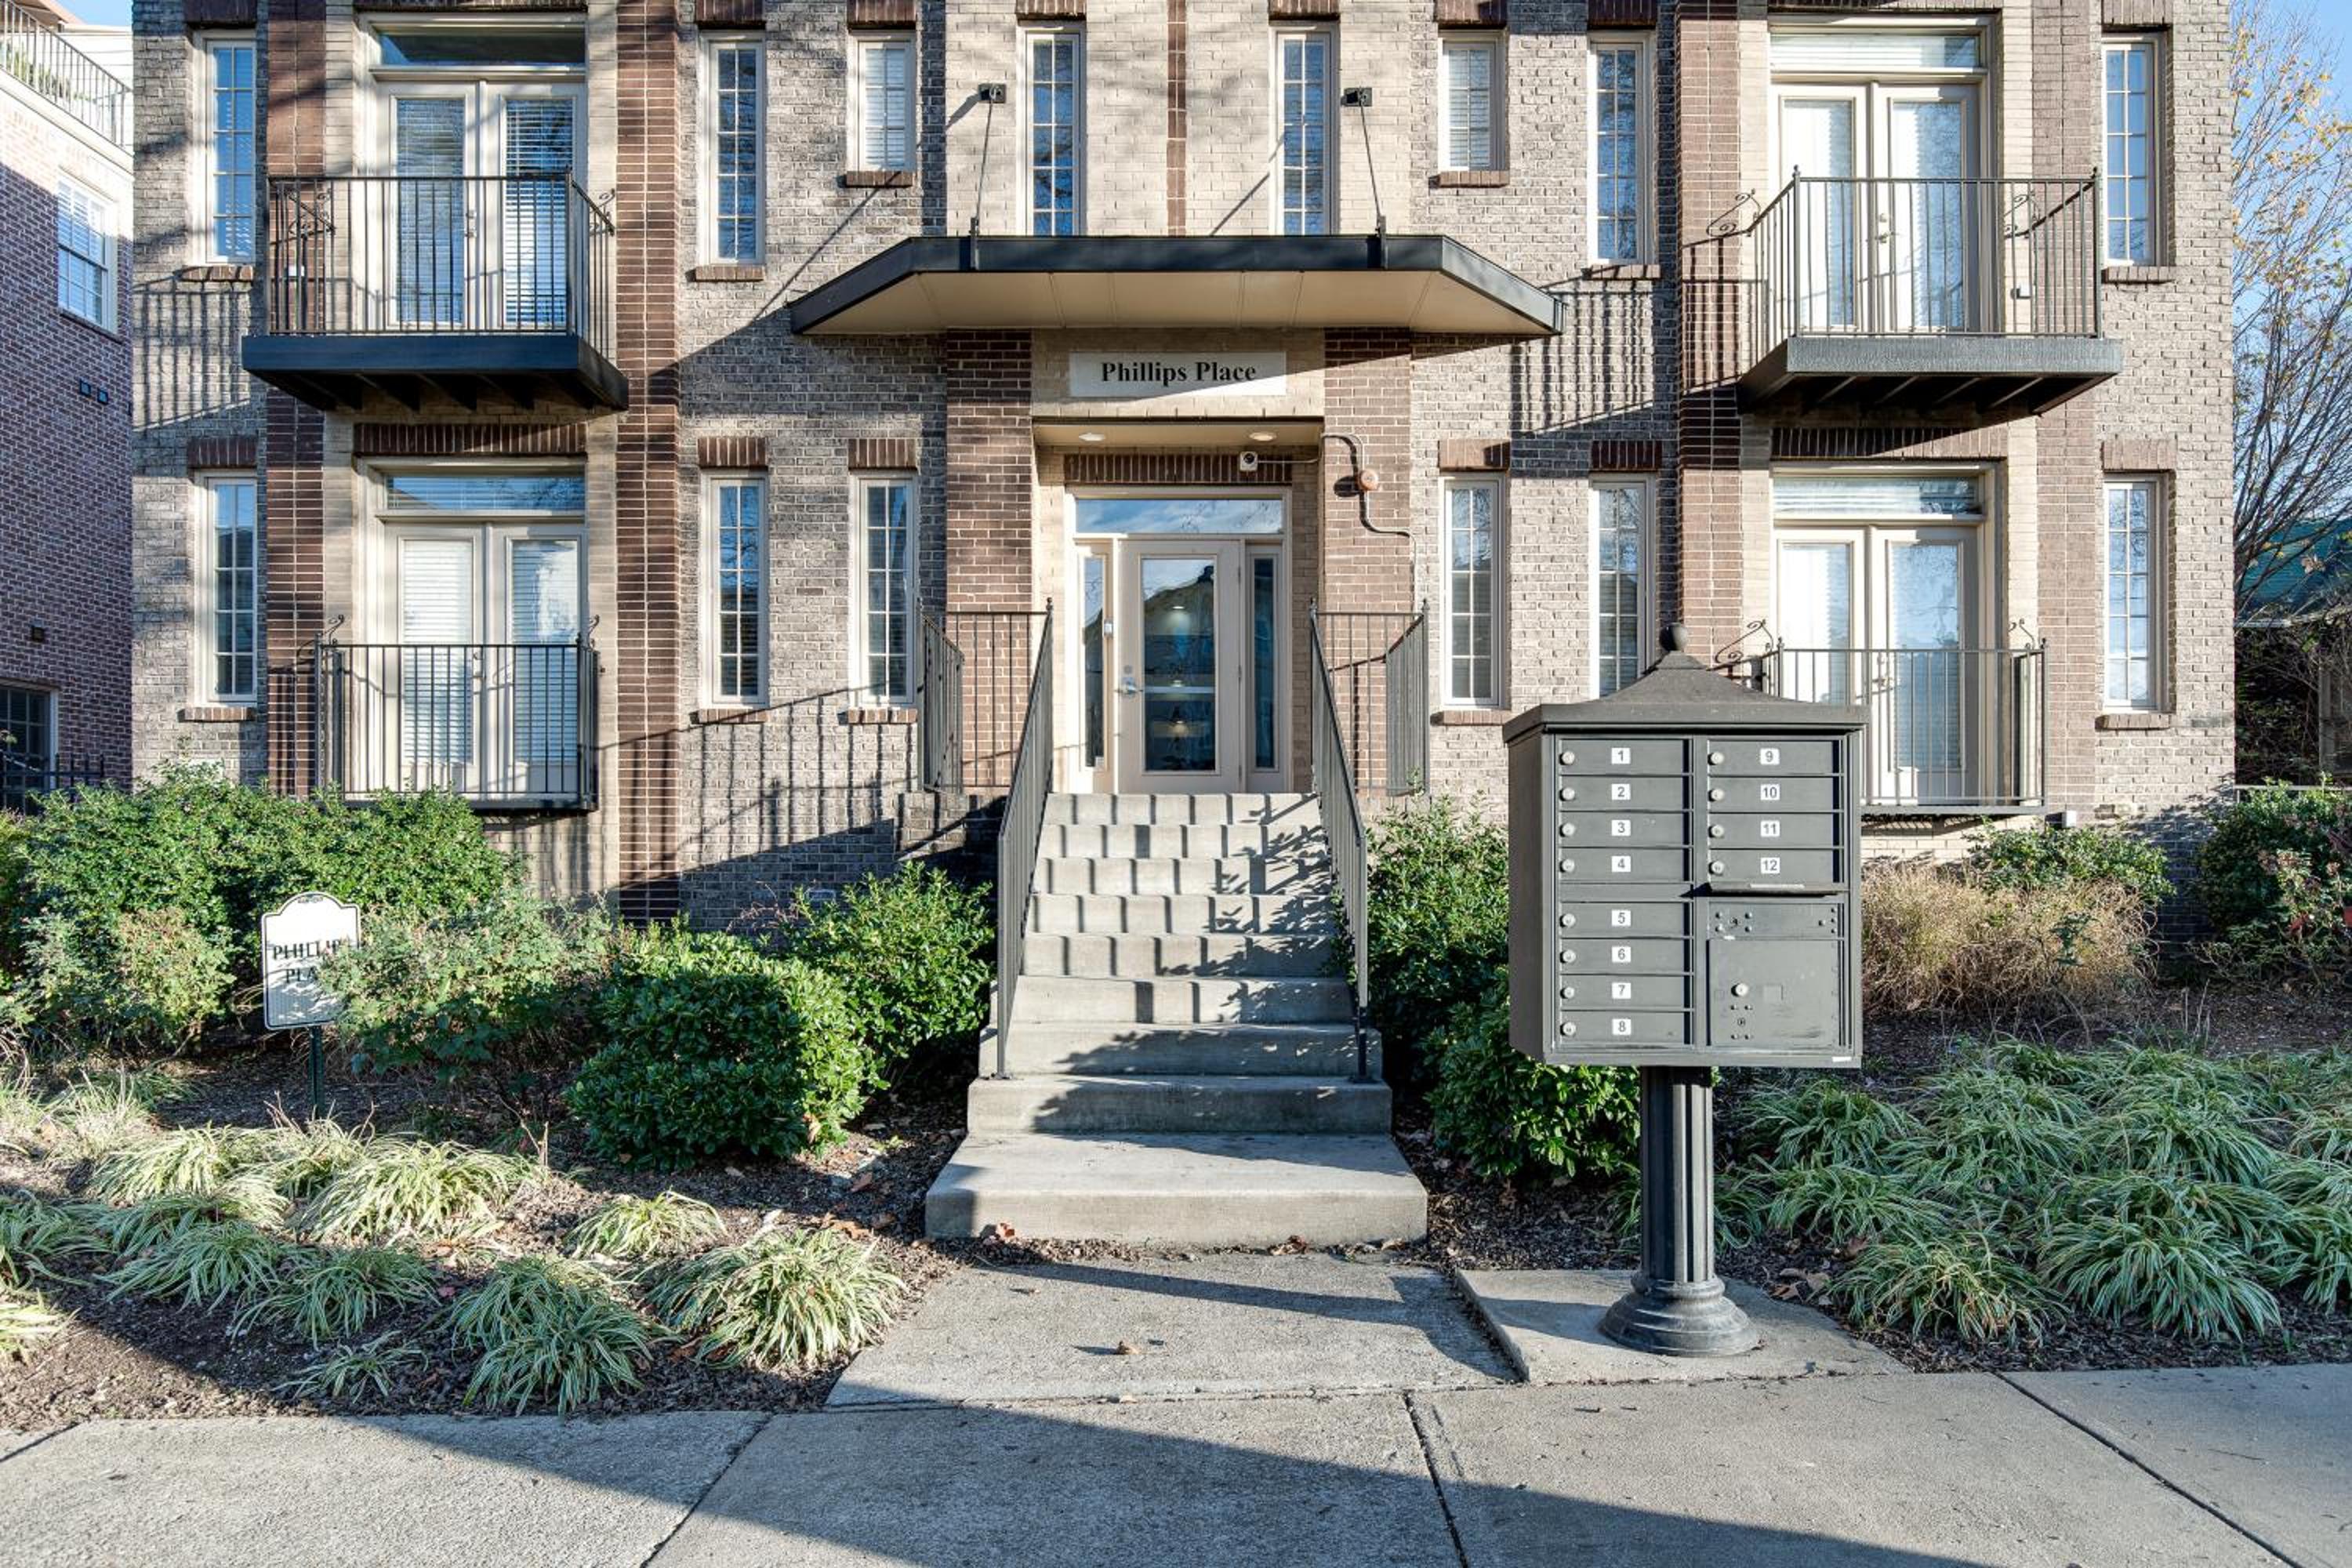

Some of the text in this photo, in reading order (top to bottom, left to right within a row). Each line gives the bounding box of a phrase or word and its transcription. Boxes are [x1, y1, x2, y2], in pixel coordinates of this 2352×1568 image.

[1101, 361, 1256, 387] Phillips Place
[1617, 750, 1624, 761] 1
[1766, 750, 1773, 762] 9
[1617, 786, 1625, 797] 2
[1763, 786, 1777, 798] 10
[1617, 822, 1625, 833] 3
[1763, 823, 1777, 834] 11
[1617, 858, 1625, 869] 4
[1763, 859, 1777, 871] 12
[1617, 913, 1625, 924] 5
[272, 939, 350, 960] PHILLIP
[1617, 949, 1626, 960] 6
[285, 967, 318, 984] PLA
[1617, 985, 1625, 996] 7
[1618, 1021, 1626, 1033] 8
